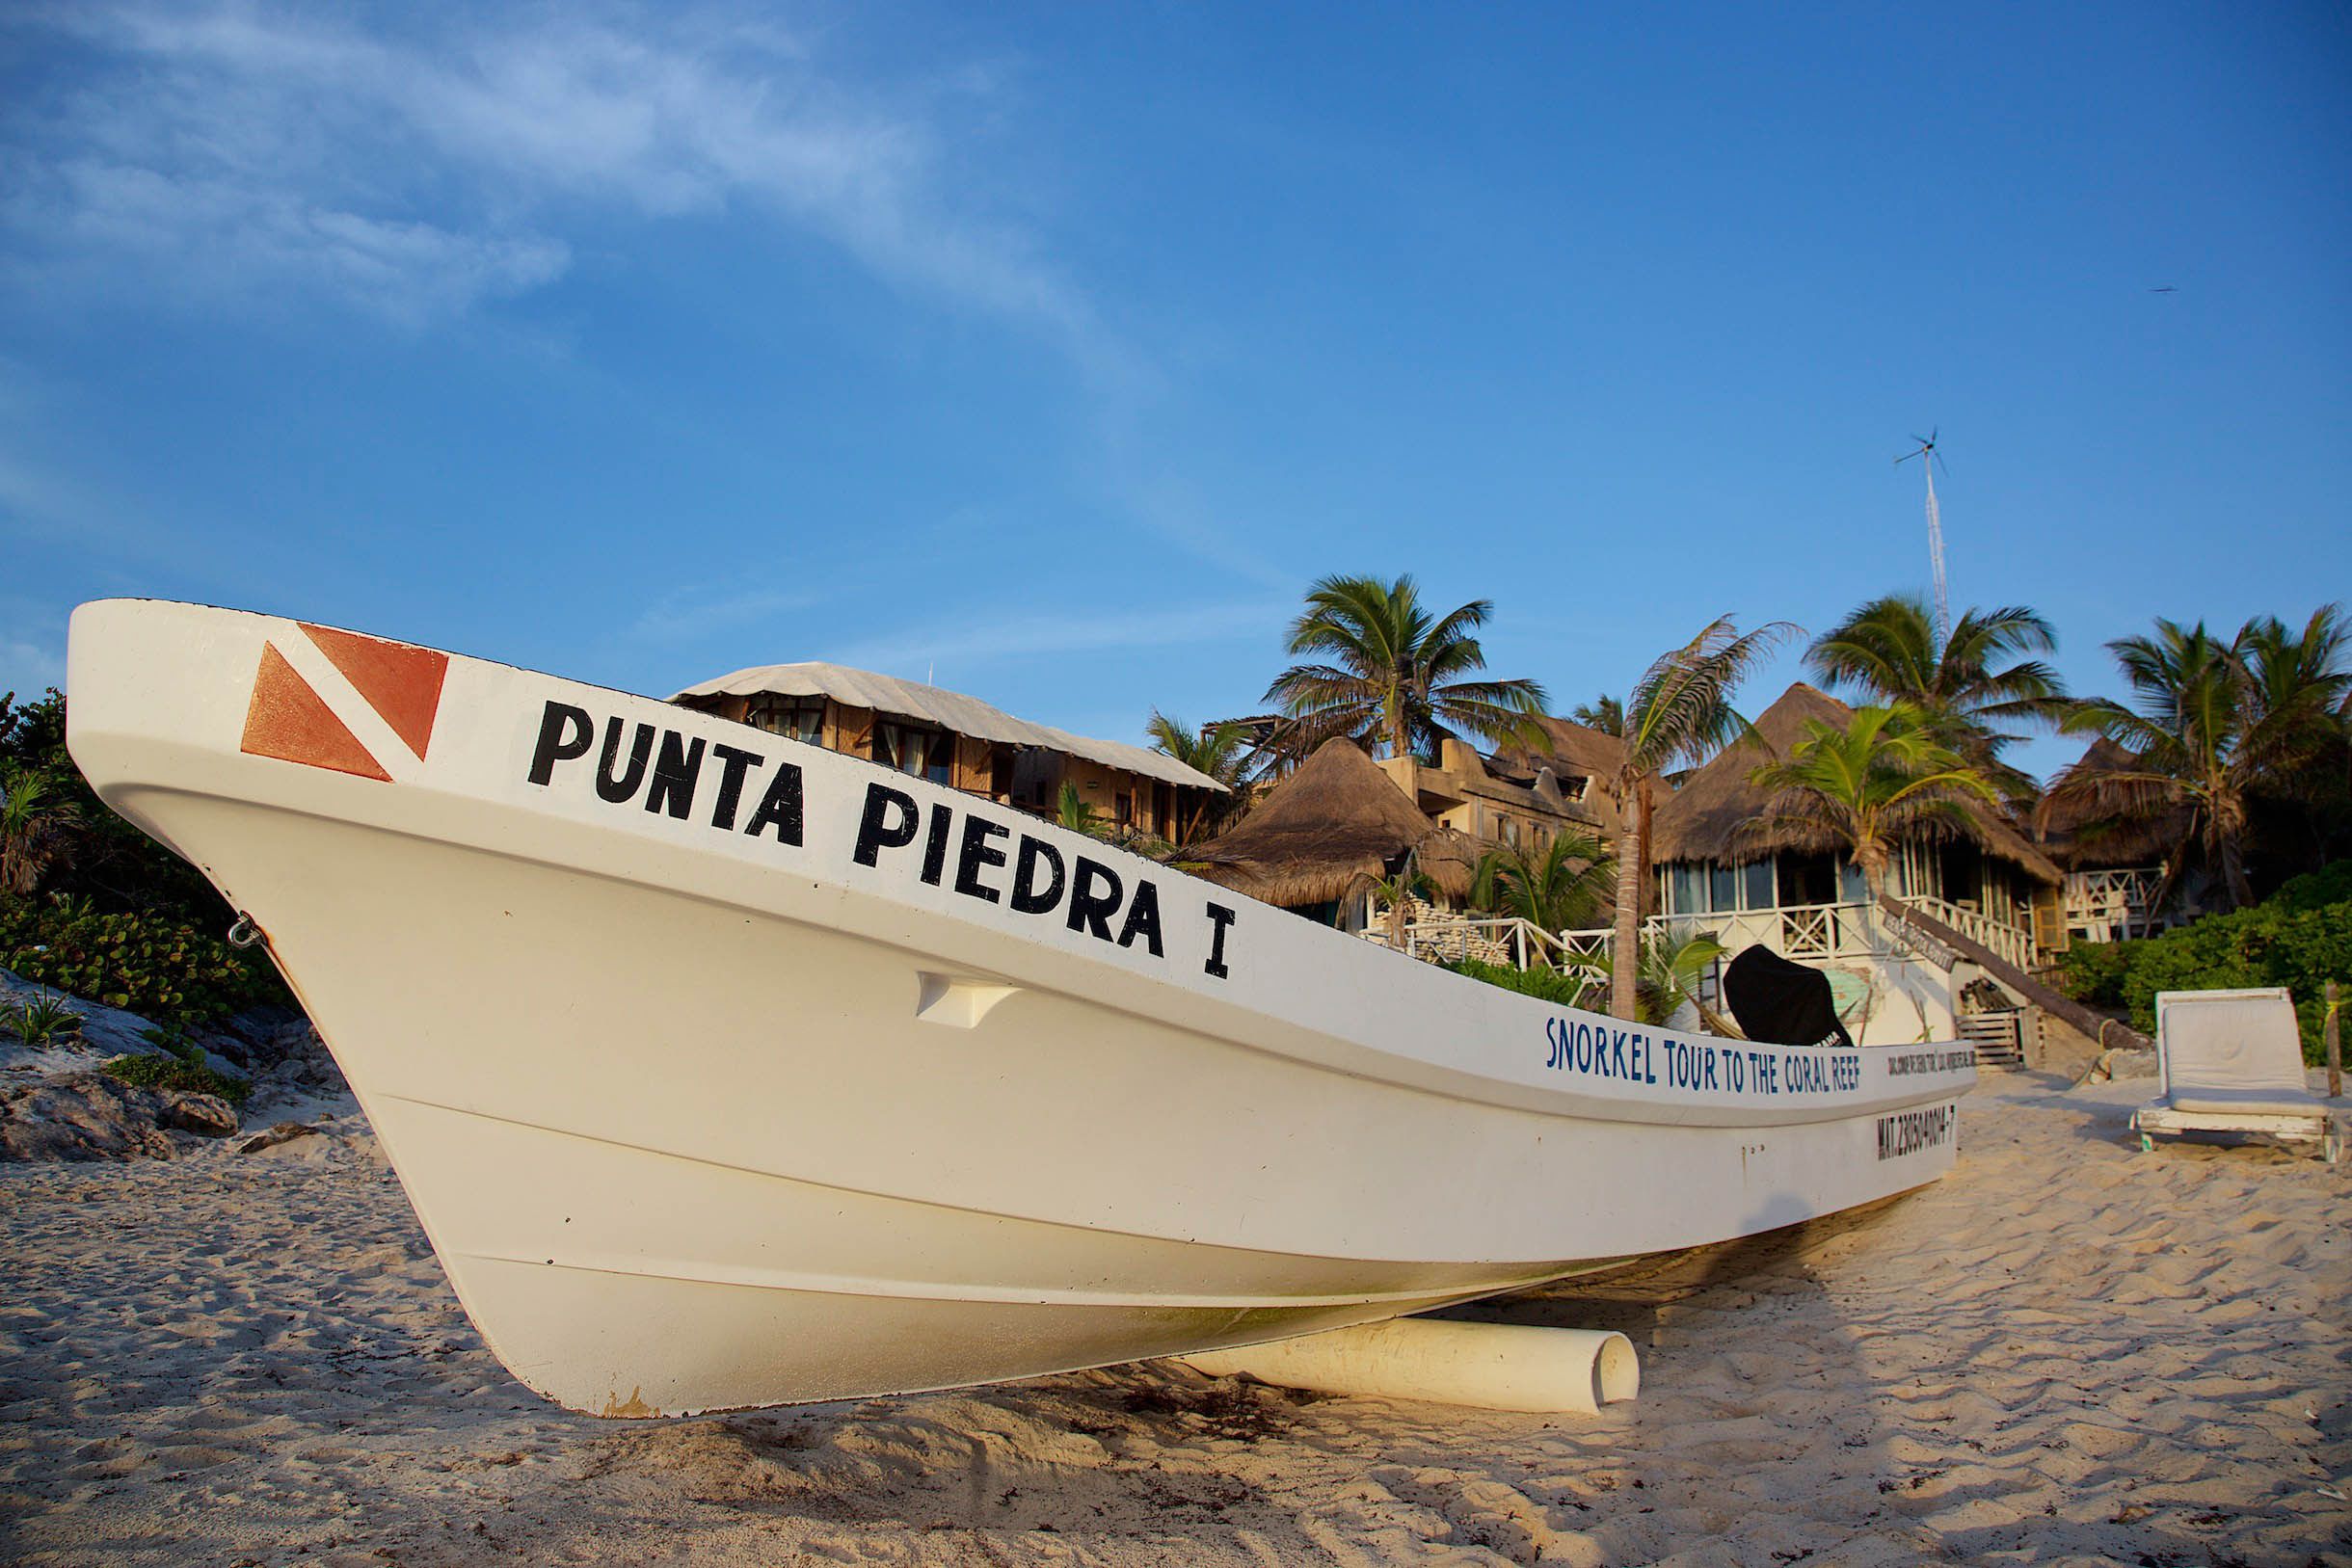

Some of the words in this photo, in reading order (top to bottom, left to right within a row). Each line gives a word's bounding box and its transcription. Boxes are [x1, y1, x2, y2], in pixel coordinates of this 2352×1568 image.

[527, 699, 804, 848] PUNTA
[852, 782, 1164, 959] PIEDRA
[1204, 901, 1236, 980] I
[1546, 1017, 1656, 1084] SNORKEL
[1664, 1040, 1719, 1092] TOUR
[1722, 1050, 1744, 1094] TO
[1749, 1052, 1778, 1095] THE
[1784, 1055, 1830, 1094] CORAL
[1832, 1055, 1860, 1091] REEF
